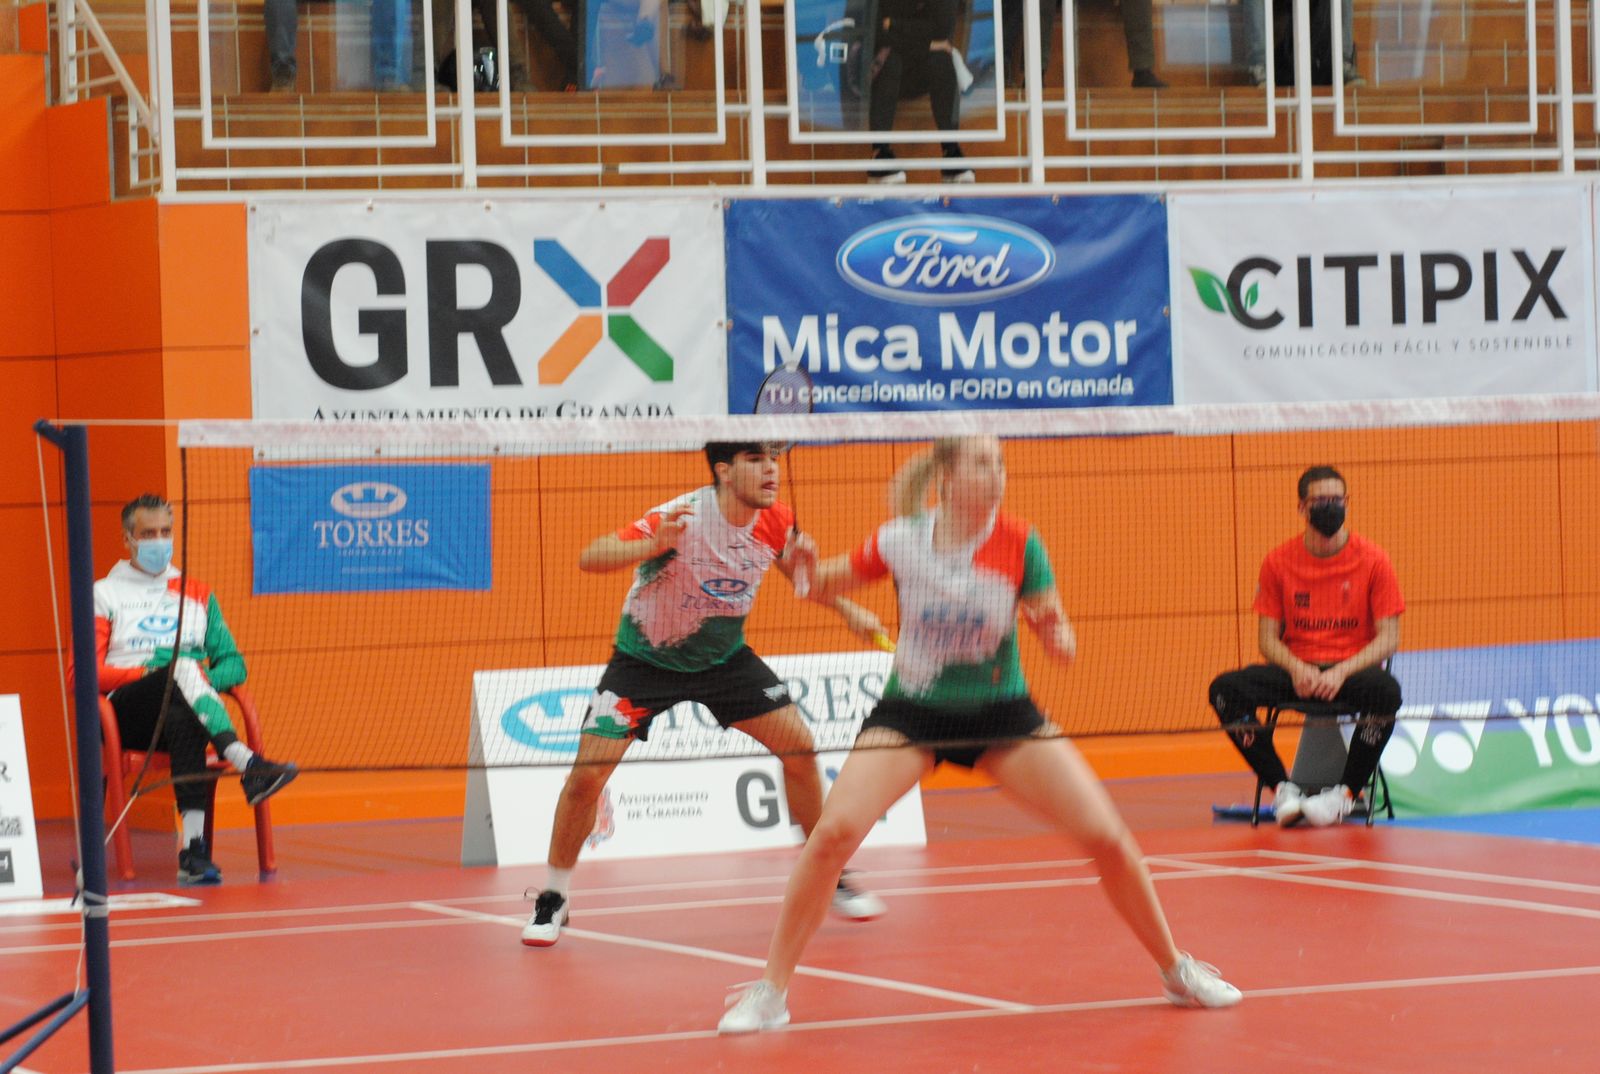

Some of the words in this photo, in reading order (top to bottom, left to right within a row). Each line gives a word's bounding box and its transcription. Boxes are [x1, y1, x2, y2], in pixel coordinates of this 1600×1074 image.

[882, 228, 1010, 288] Ford
[1225, 247, 1568, 331] CITIPIX
[301, 237, 674, 391] GRX
[762, 312, 921, 373] Mica
[939, 311, 1137, 370] Motor
[1243, 340, 1383, 360] COMUNICACIÓN
[1394, 338, 1440, 352] FÁCIL
[1451, 338, 1460, 351] Y
[1469, 335, 1572, 352] SOSTENIBLE
[765, 384, 793, 404] Tu
[798, 379, 946, 403] concesionario
[950, 378, 1013, 400] FORD
[1016, 380, 1043, 398] en
[1046, 373, 1135, 398] Granada
[313, 519, 430, 548] TORRES
[1294, 616, 1359, 631] VOLUNTARIO
